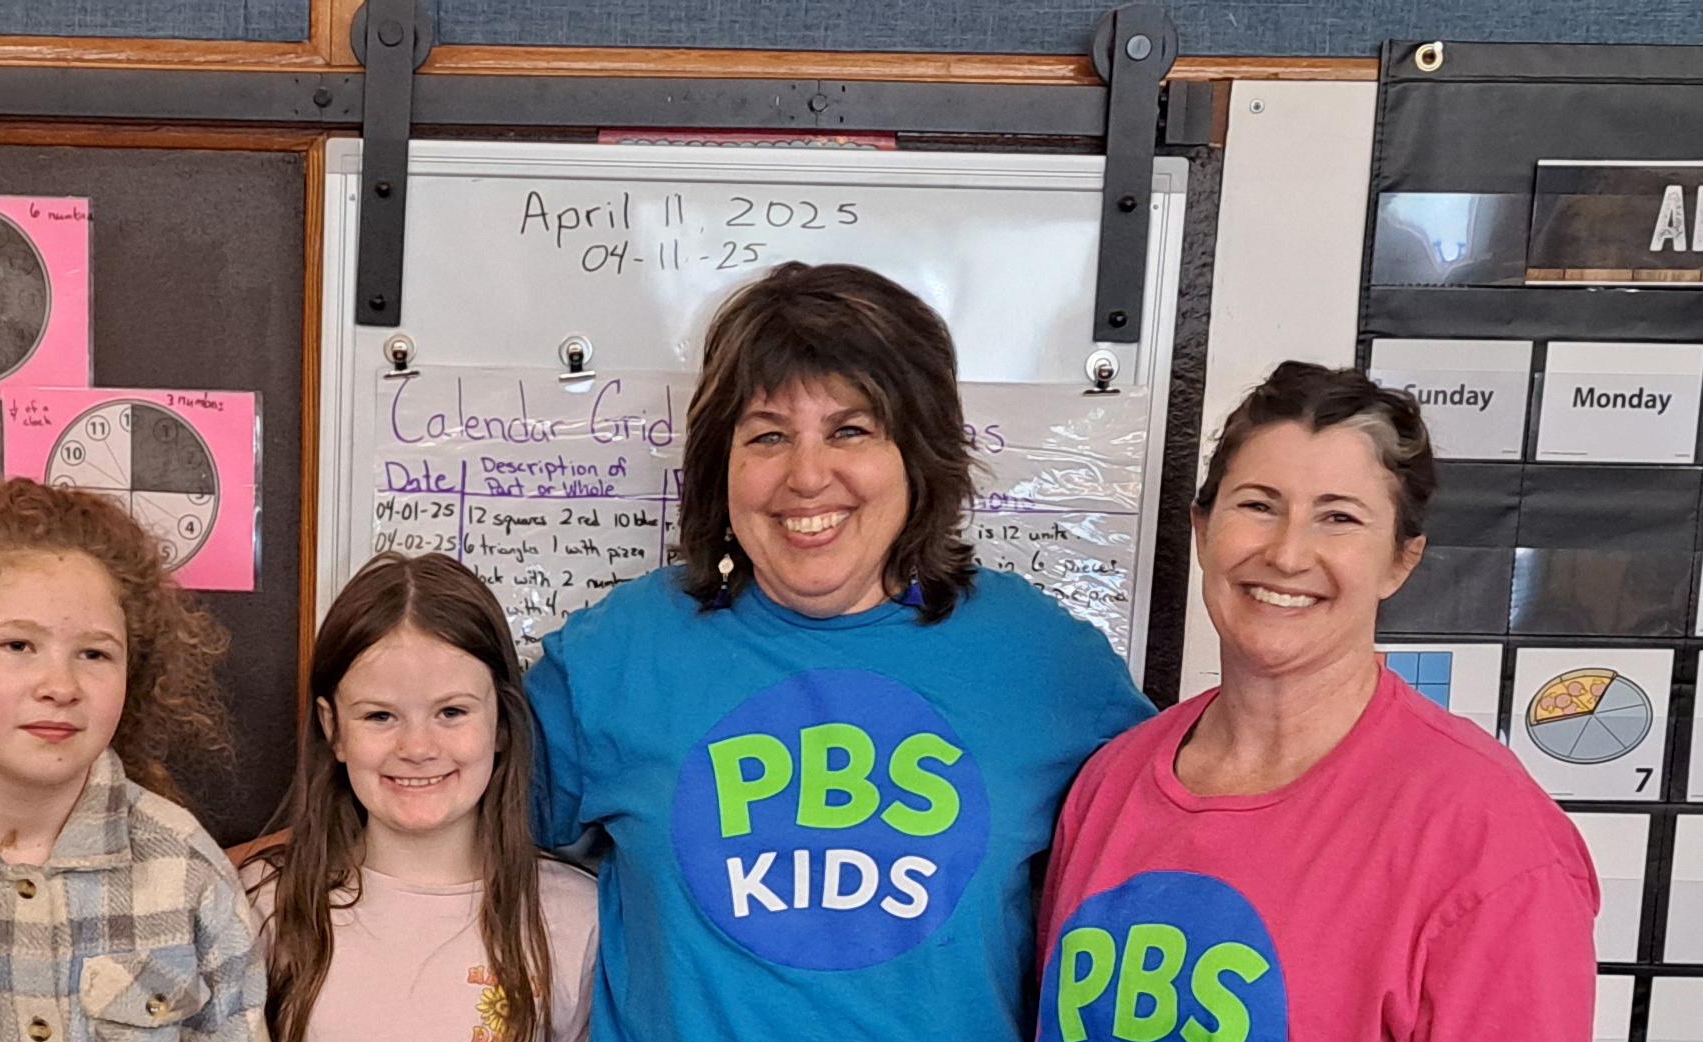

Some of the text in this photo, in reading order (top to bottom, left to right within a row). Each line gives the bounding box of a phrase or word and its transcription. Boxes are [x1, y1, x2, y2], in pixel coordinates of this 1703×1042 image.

[521, 191, 629, 248] April
[725, 198, 859, 230] 2025
[582, 239, 767, 274] 04-11-25
[391, 377, 673, 447] Calendar Grid
[1572, 386, 1673, 415] Monday
[90, 421, 105, 435] 11
[64, 446, 83, 460] 10
[385, 456, 627, 492] Date Description of
[484, 477, 615, 497] Part or Whole
[376, 495, 455, 523] 04-01-25
[467, 504, 487, 525] 12
[561, 508, 574, 527] 2
[577, 508, 601, 528] red
[614, 512, 630, 528] 10
[185, 521, 194, 534] 4
[978, 524, 994, 540] is
[1002, 526, 1020, 541] 12
[374, 528, 457, 552] 04-02-25
[463, 535, 475, 555] 6
[565, 536, 601, 559] with
[1031, 550, 1045, 573] 6
[514, 567, 551, 588] with
[562, 570, 574, 588] 2
[708, 722, 963, 838] PBS
[1634, 768, 1654, 792] 7
[726, 848, 938, 918] KIDS
